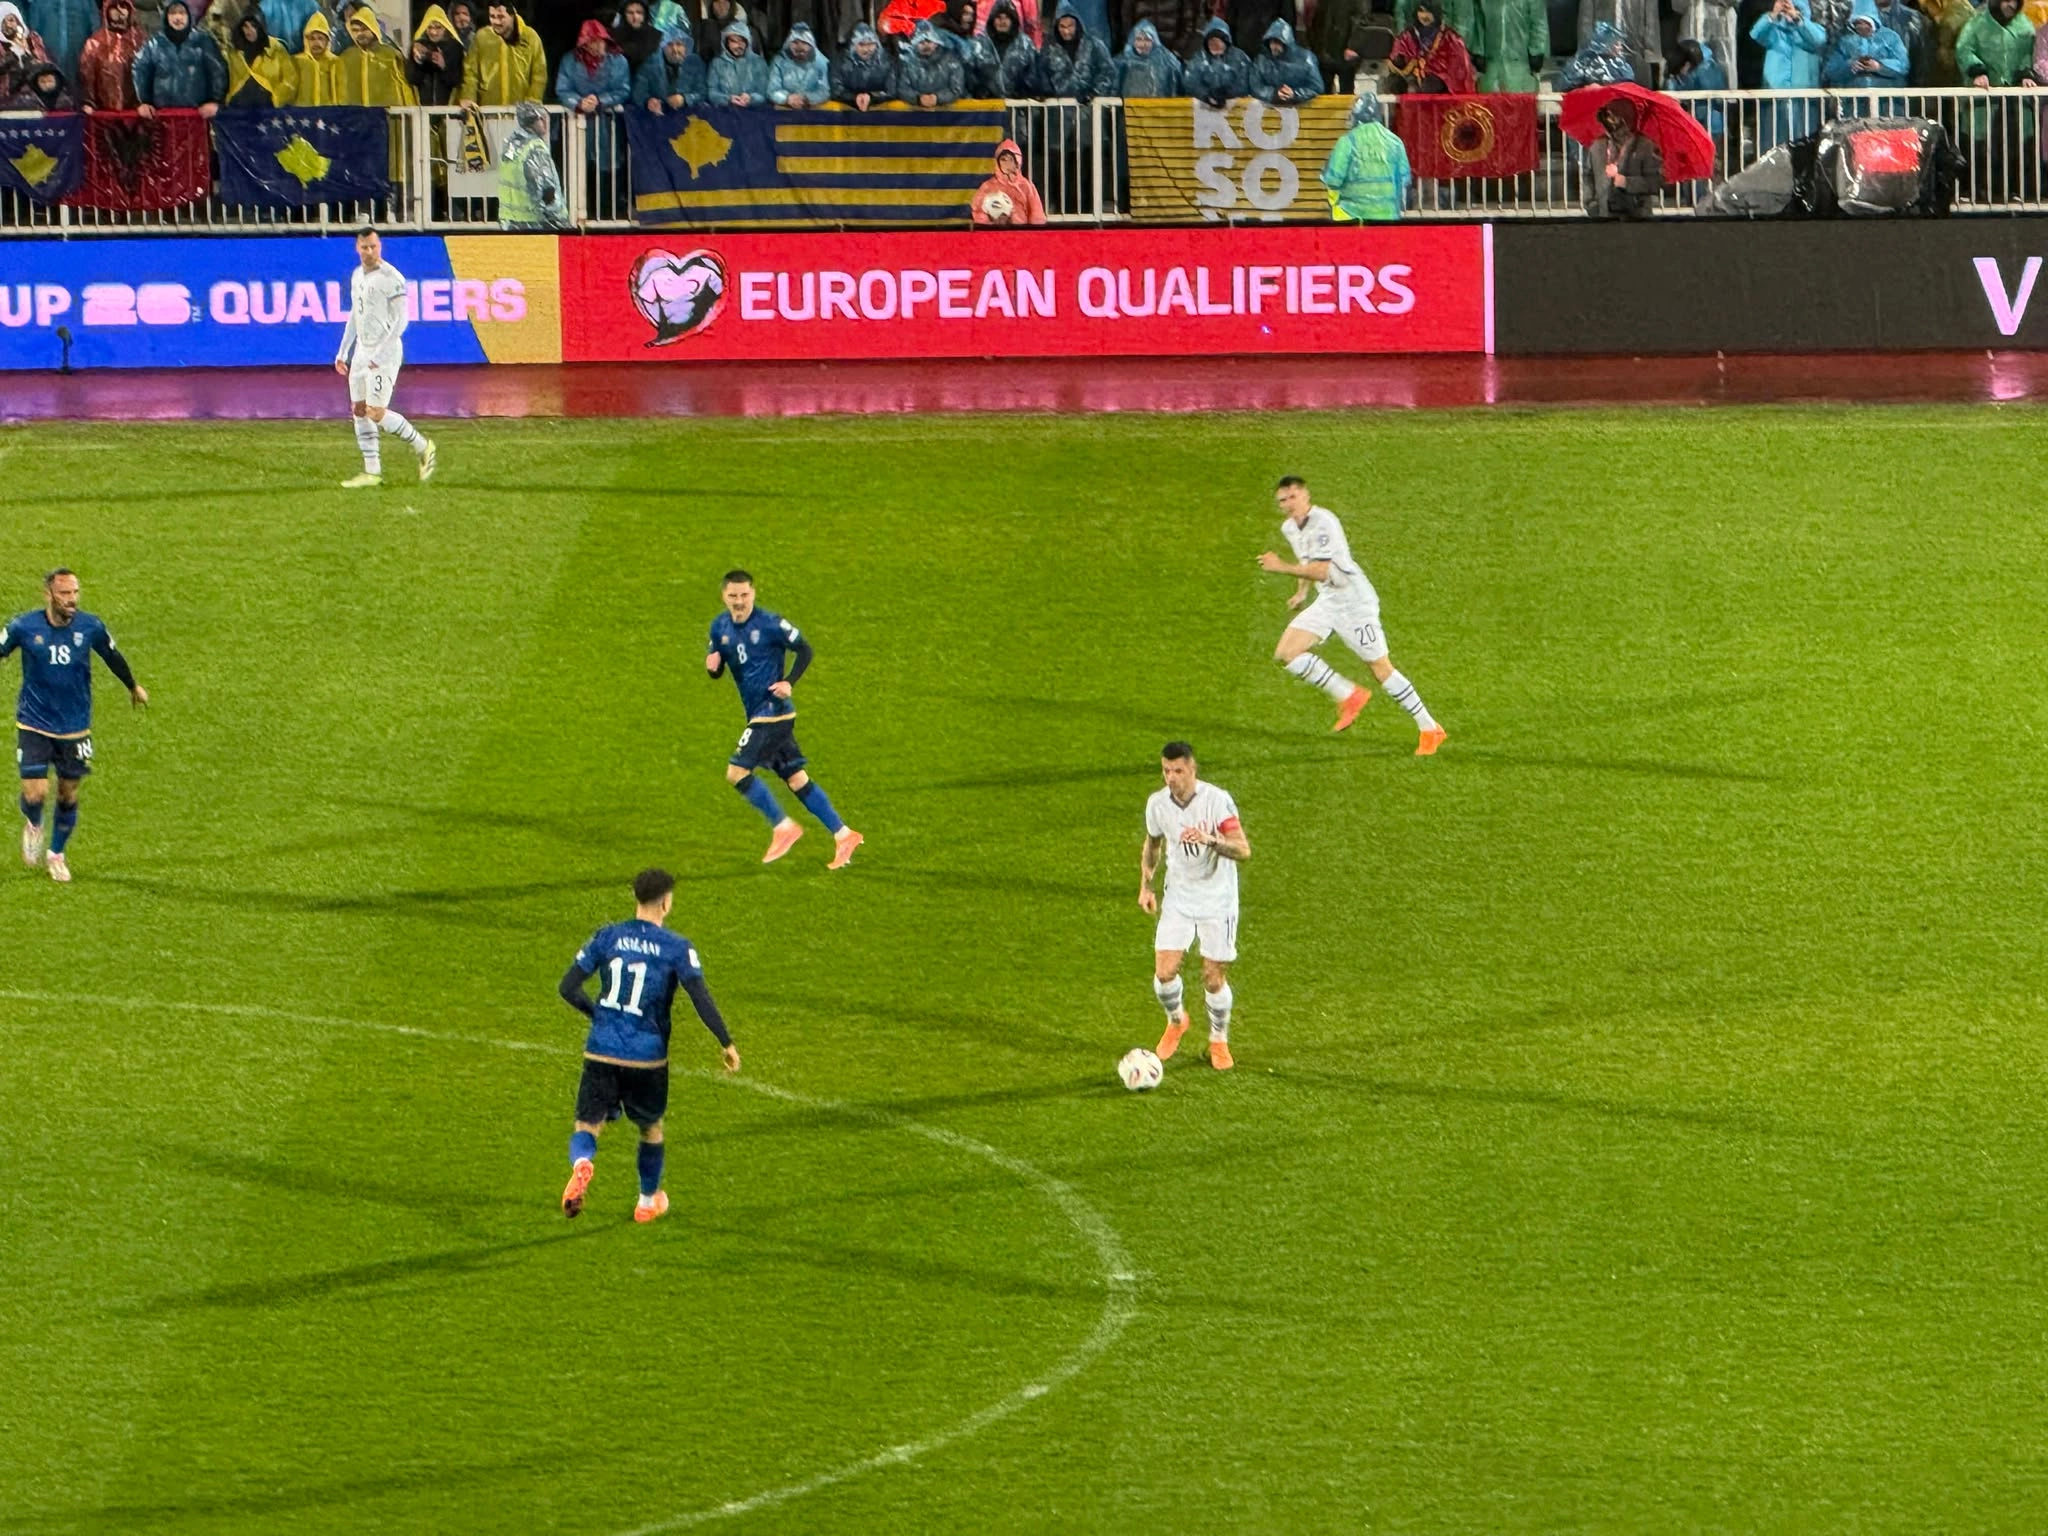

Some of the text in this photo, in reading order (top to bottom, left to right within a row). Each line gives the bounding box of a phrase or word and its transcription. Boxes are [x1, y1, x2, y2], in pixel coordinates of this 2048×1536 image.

[1193, 97, 1299, 150] KO
[1194, 152, 1299, 210] SO
[0, 283, 71, 327] UP
[82, 282, 191, 325] 26
[739, 264, 1416, 320] EUROPEAN QUALIFIERS
[1973, 256, 2043, 336] V
[374, 375, 383, 393] 3
[49, 645, 71, 664] 18
[737, 643, 747, 664] 8
[1355, 623, 1376, 645] 20
[738, 727, 752, 747] 8
[600, 957, 647, 1016] 11
